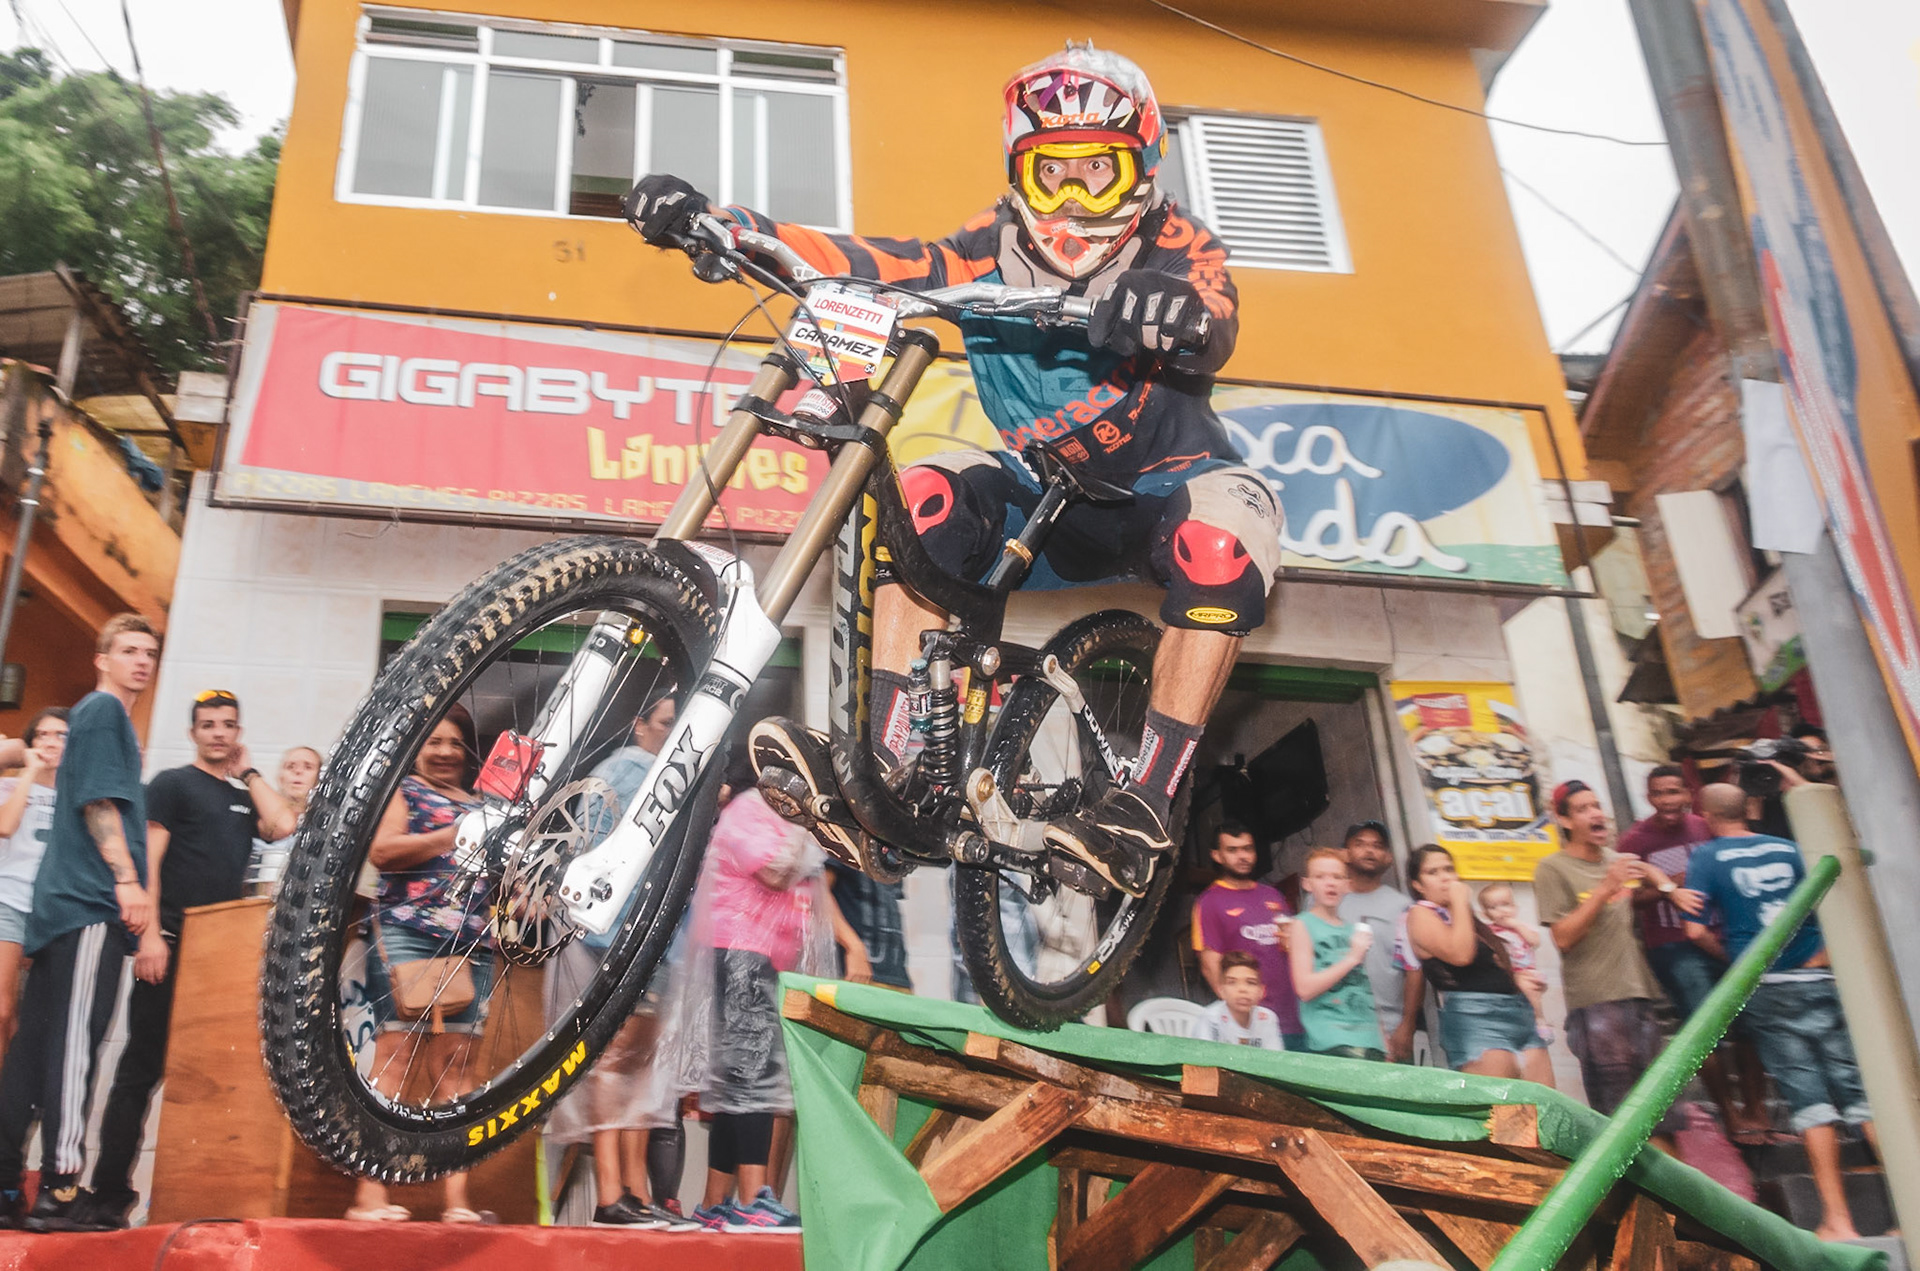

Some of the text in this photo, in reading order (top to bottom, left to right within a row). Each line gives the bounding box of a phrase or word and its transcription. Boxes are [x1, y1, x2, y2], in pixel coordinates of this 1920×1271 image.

[814, 299, 883, 324] LORENZETTI
[587, 426, 808, 494] Lanes
[488, 489, 588, 512] PIZZAS
[604, 497, 724, 523] LANCS
[634, 724, 704, 847] FOX
[468, 1040, 588, 1147] MAXXIS
